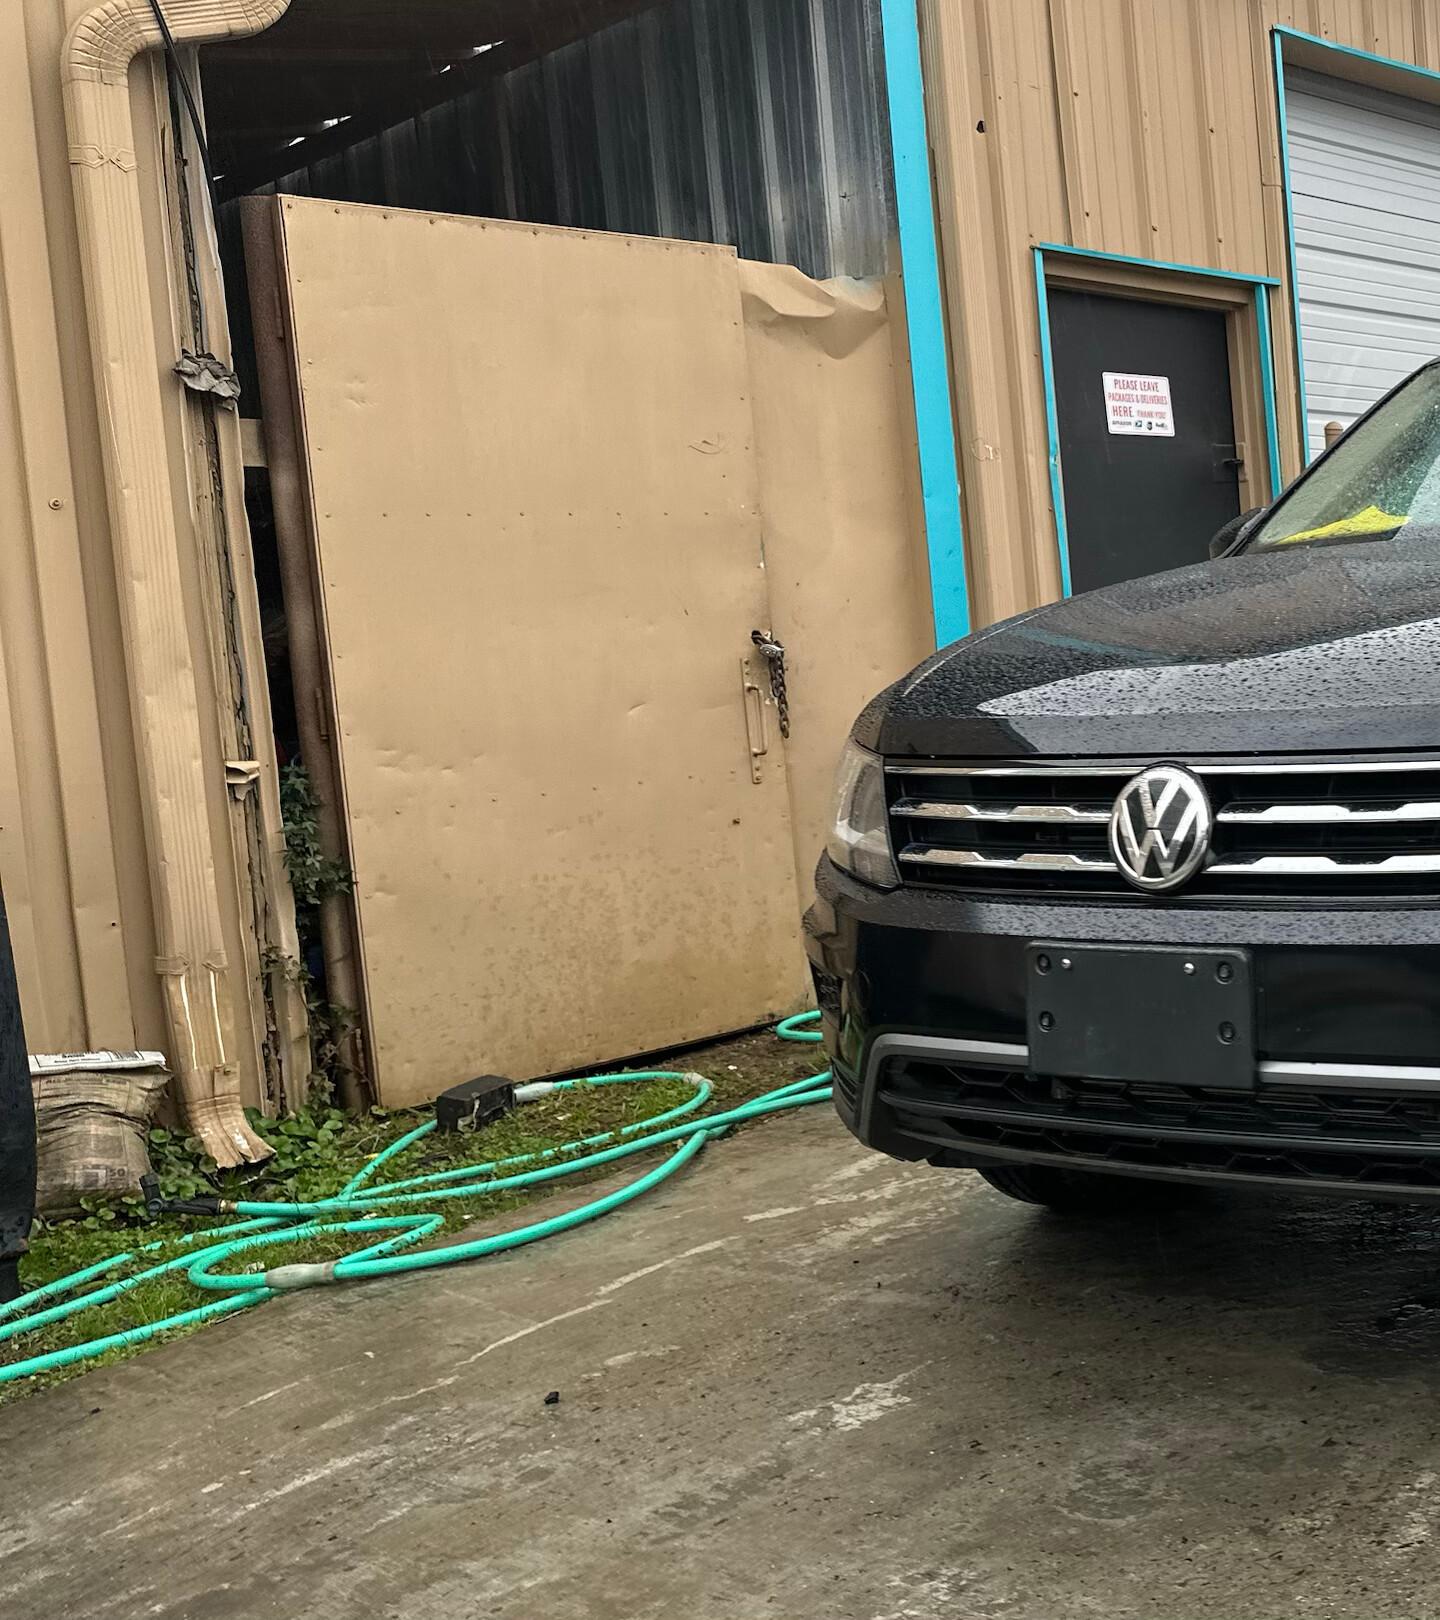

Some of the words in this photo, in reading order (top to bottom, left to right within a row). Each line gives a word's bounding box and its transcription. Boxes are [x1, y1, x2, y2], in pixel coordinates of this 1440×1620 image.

[1113, 379, 1138, 391] PLEASE
[1140, 381, 1159, 392] LEAVE
[1108, 392, 1135, 403] PACKAGES
[1140, 394, 1168, 405] DELIVERIES
[1137, 410, 1154, 418] THANK
